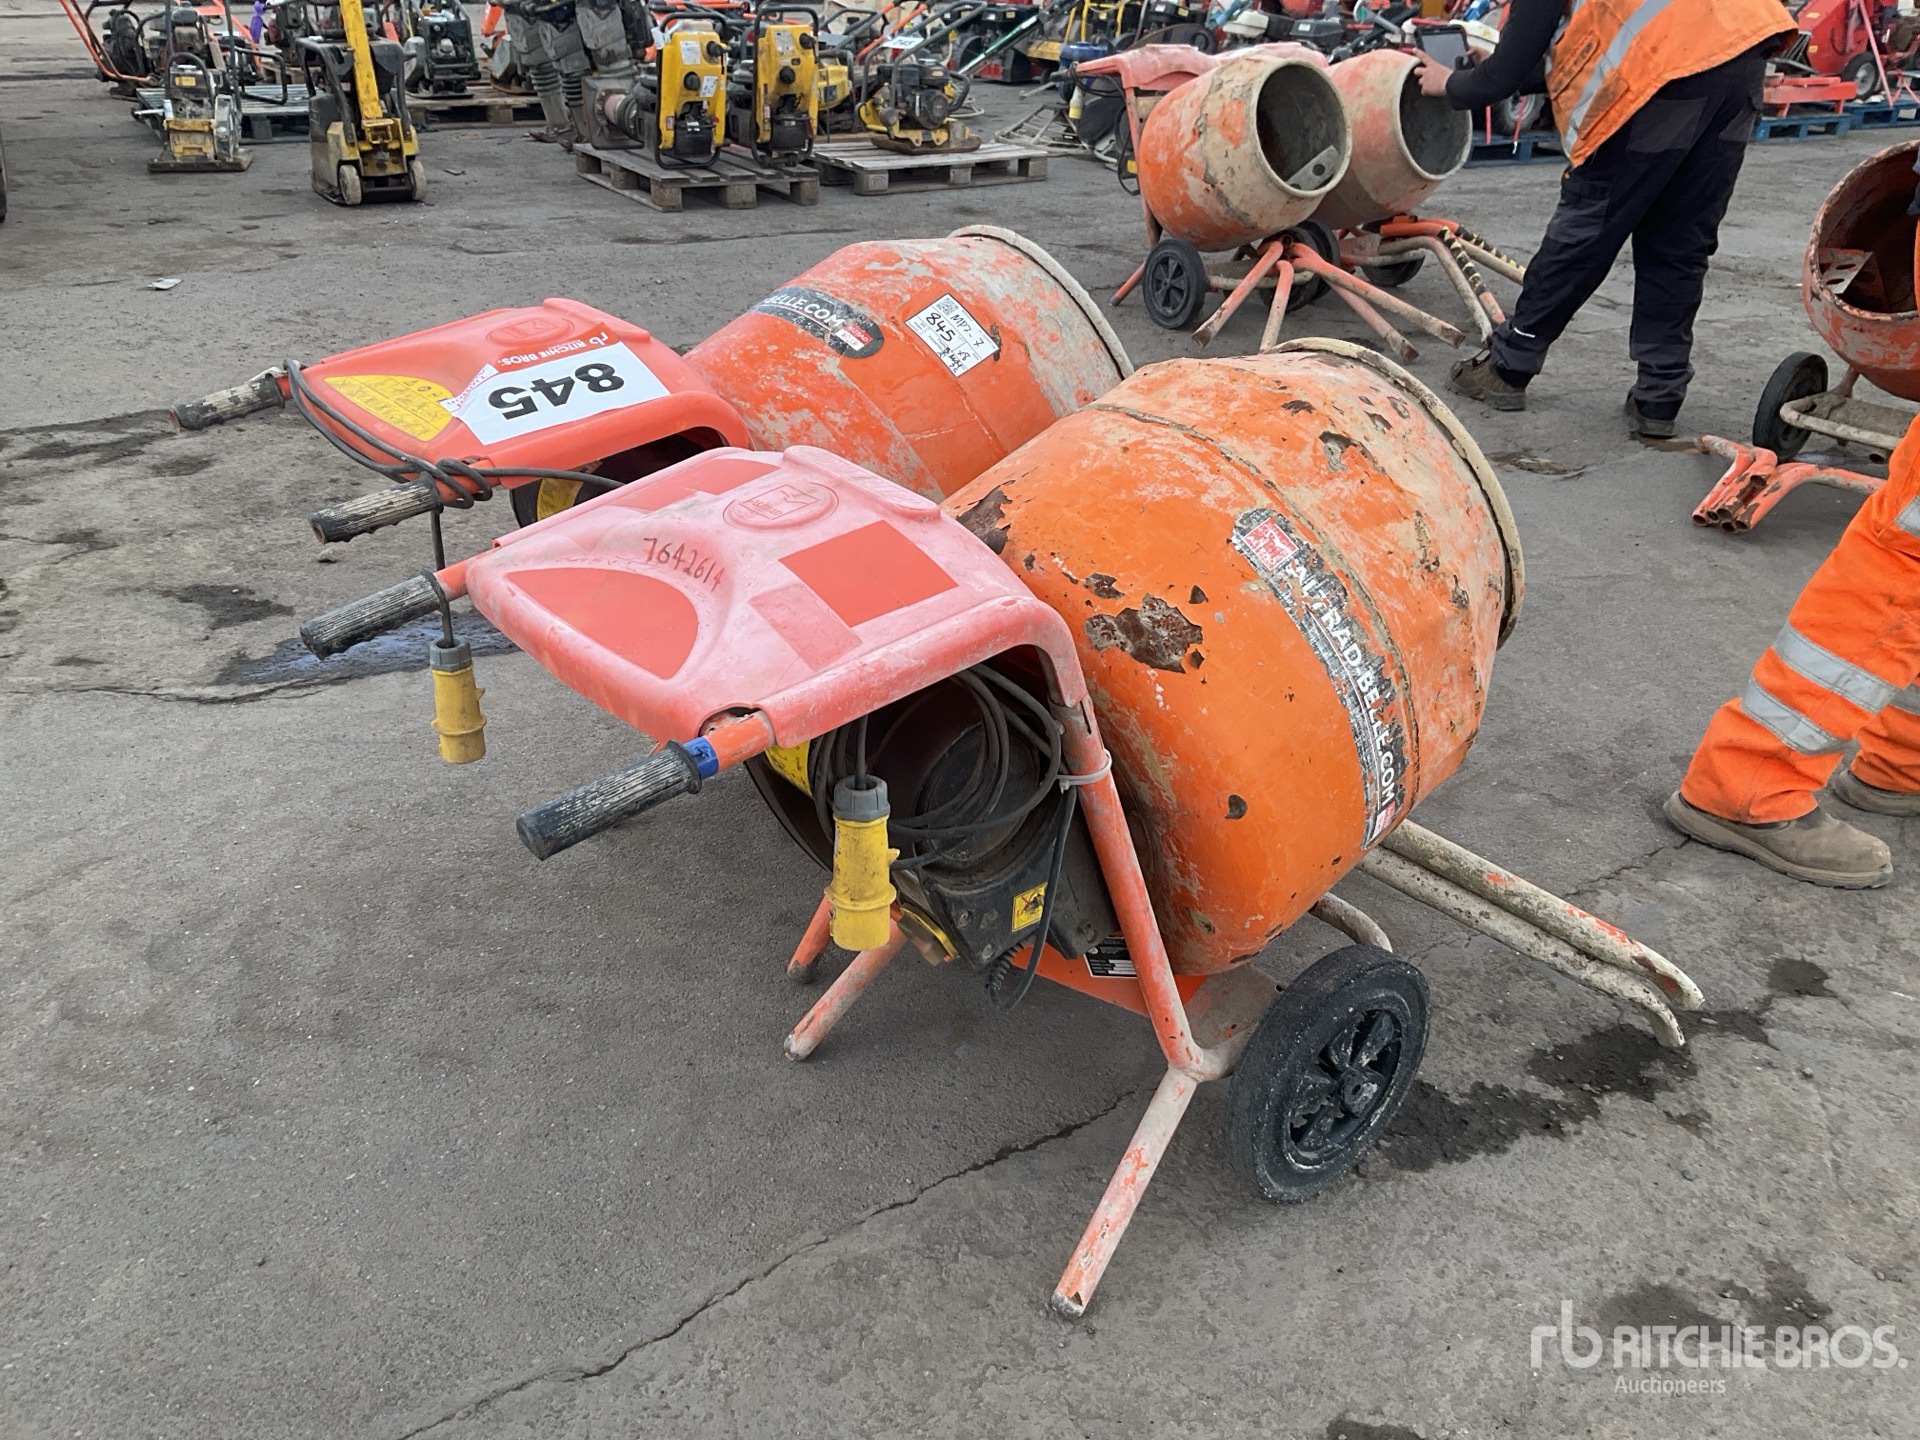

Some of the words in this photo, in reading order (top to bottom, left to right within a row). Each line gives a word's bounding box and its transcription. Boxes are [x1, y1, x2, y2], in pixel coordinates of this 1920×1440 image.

[926, 312, 956, 342] 845
[498, 353, 539, 366] BROS.
[538, 339, 587, 359] RITCHIE
[488, 363, 625, 420] 845
[643, 537, 725, 593] 7642614
